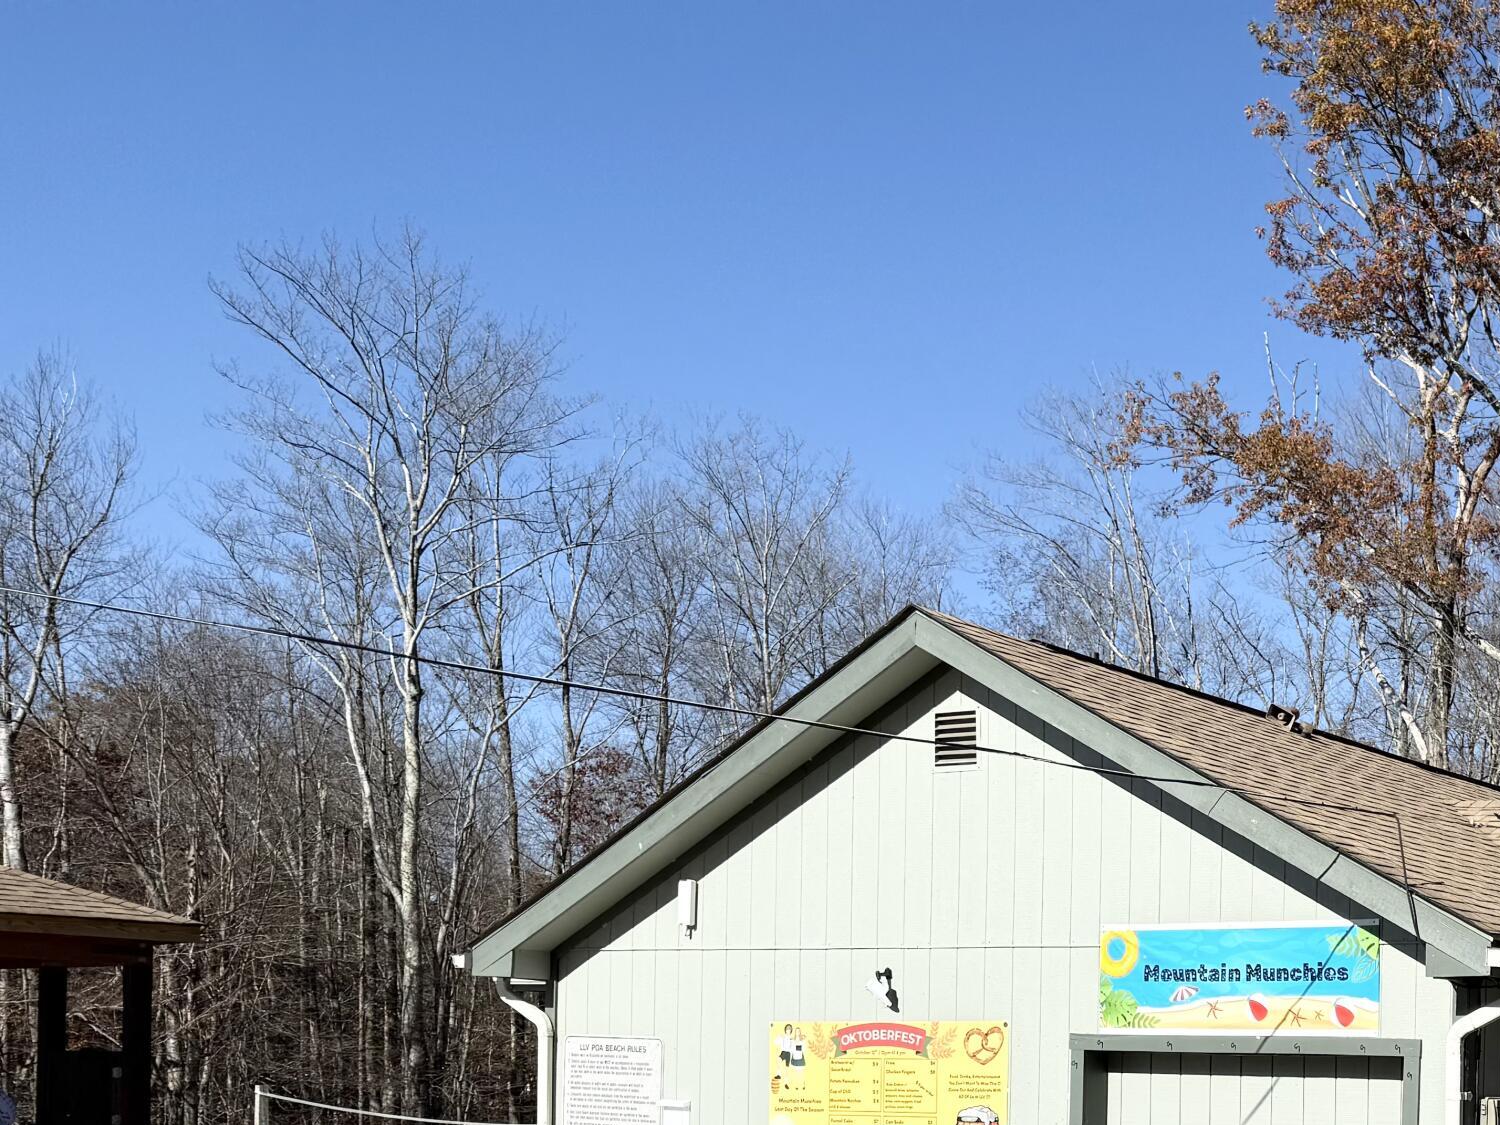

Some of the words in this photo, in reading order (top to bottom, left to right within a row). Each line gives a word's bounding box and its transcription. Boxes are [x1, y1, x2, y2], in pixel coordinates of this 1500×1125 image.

[1143, 963, 1241, 982] Mountain
[1246, 962, 1349, 982] Munchies
[841, 1029, 922, 1046] OKTOBERFEST
[605, 1044, 626, 1052] BEACH
[627, 1045, 647, 1053] RULES
